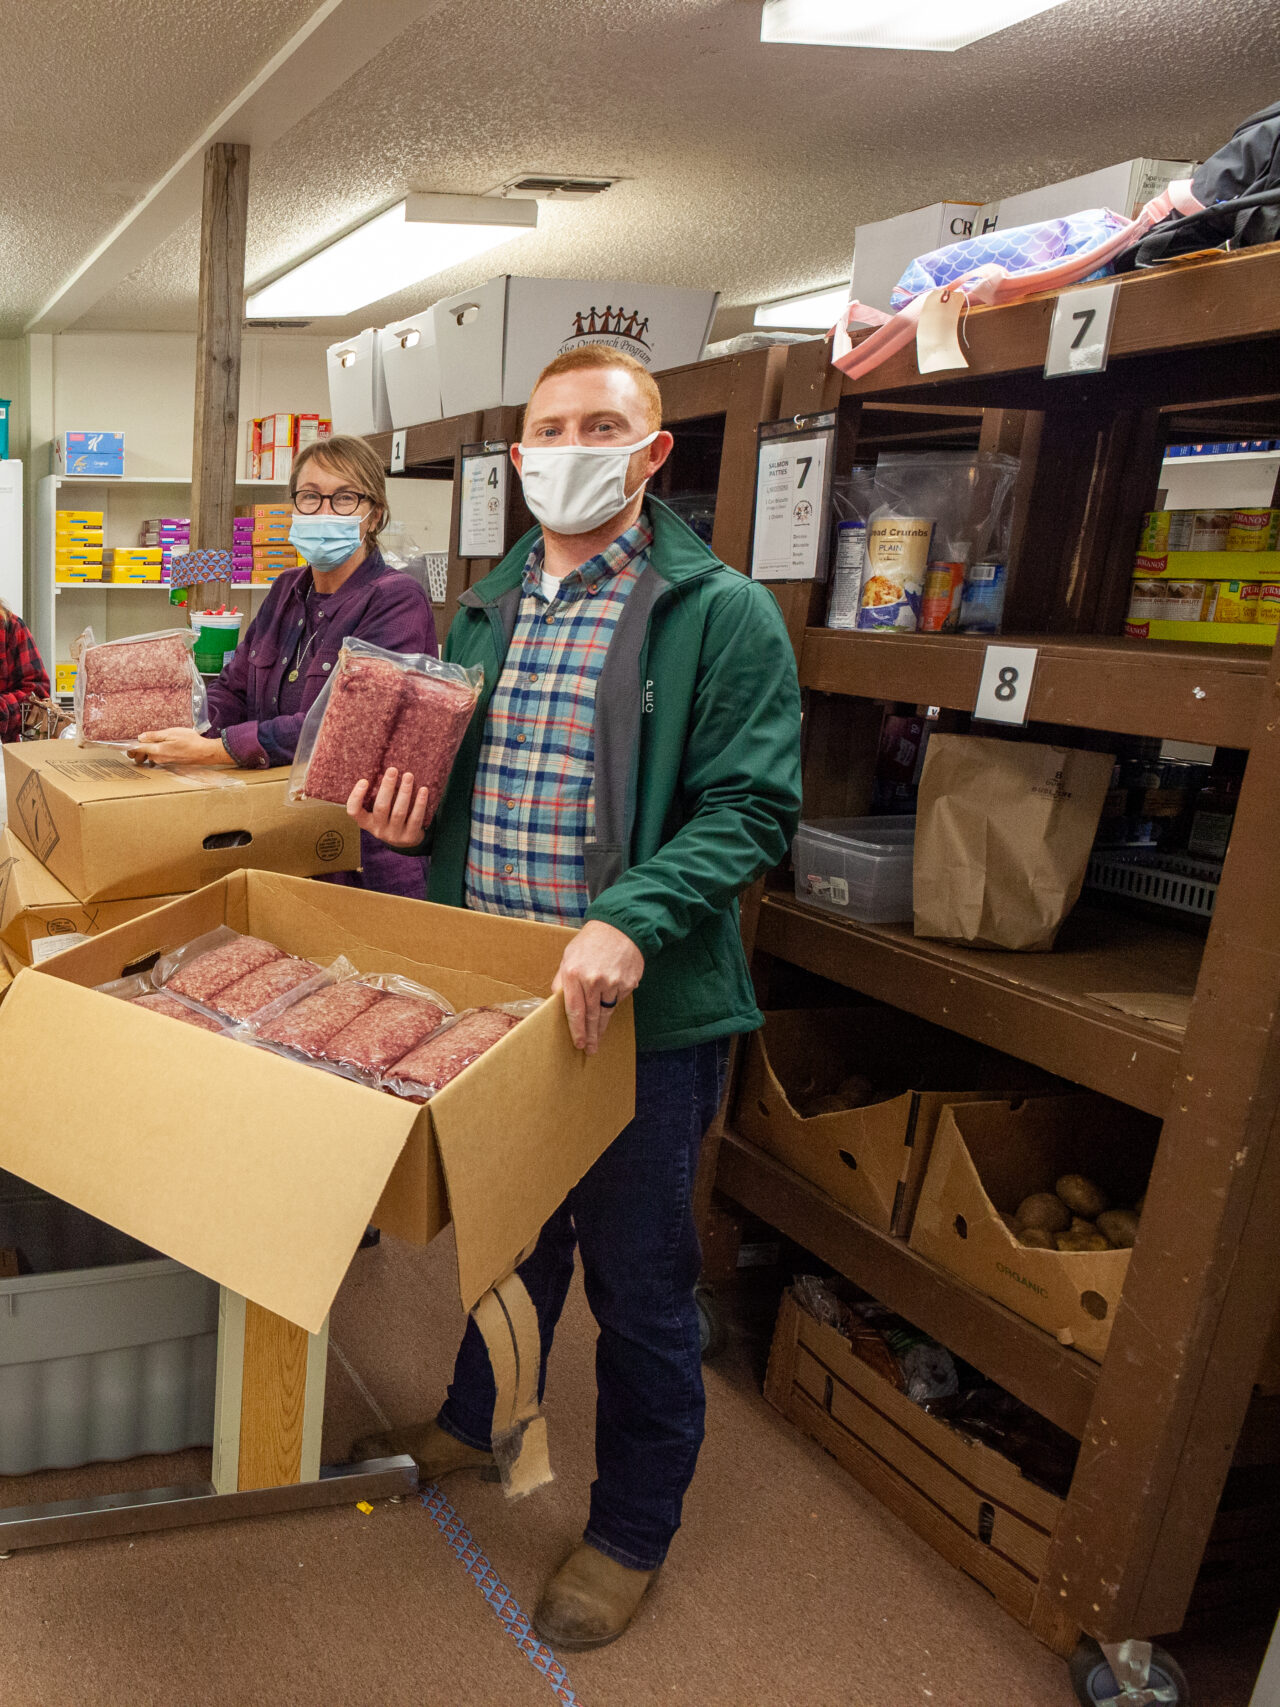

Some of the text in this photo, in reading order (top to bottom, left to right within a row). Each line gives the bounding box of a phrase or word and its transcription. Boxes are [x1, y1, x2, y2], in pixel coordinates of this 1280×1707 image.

[1070, 308, 1096, 349] 7
[620, 340, 651, 364] Program
[394, 441, 401, 460] 1
[487, 466, 498, 489] 4
[796, 456, 812, 489] 7
[889, 529, 928, 537] Crumbs
[878, 544, 903, 552] PLAIN
[994, 666, 1019, 701] 8
[995, 1261, 1049, 1300] ORGANIC
